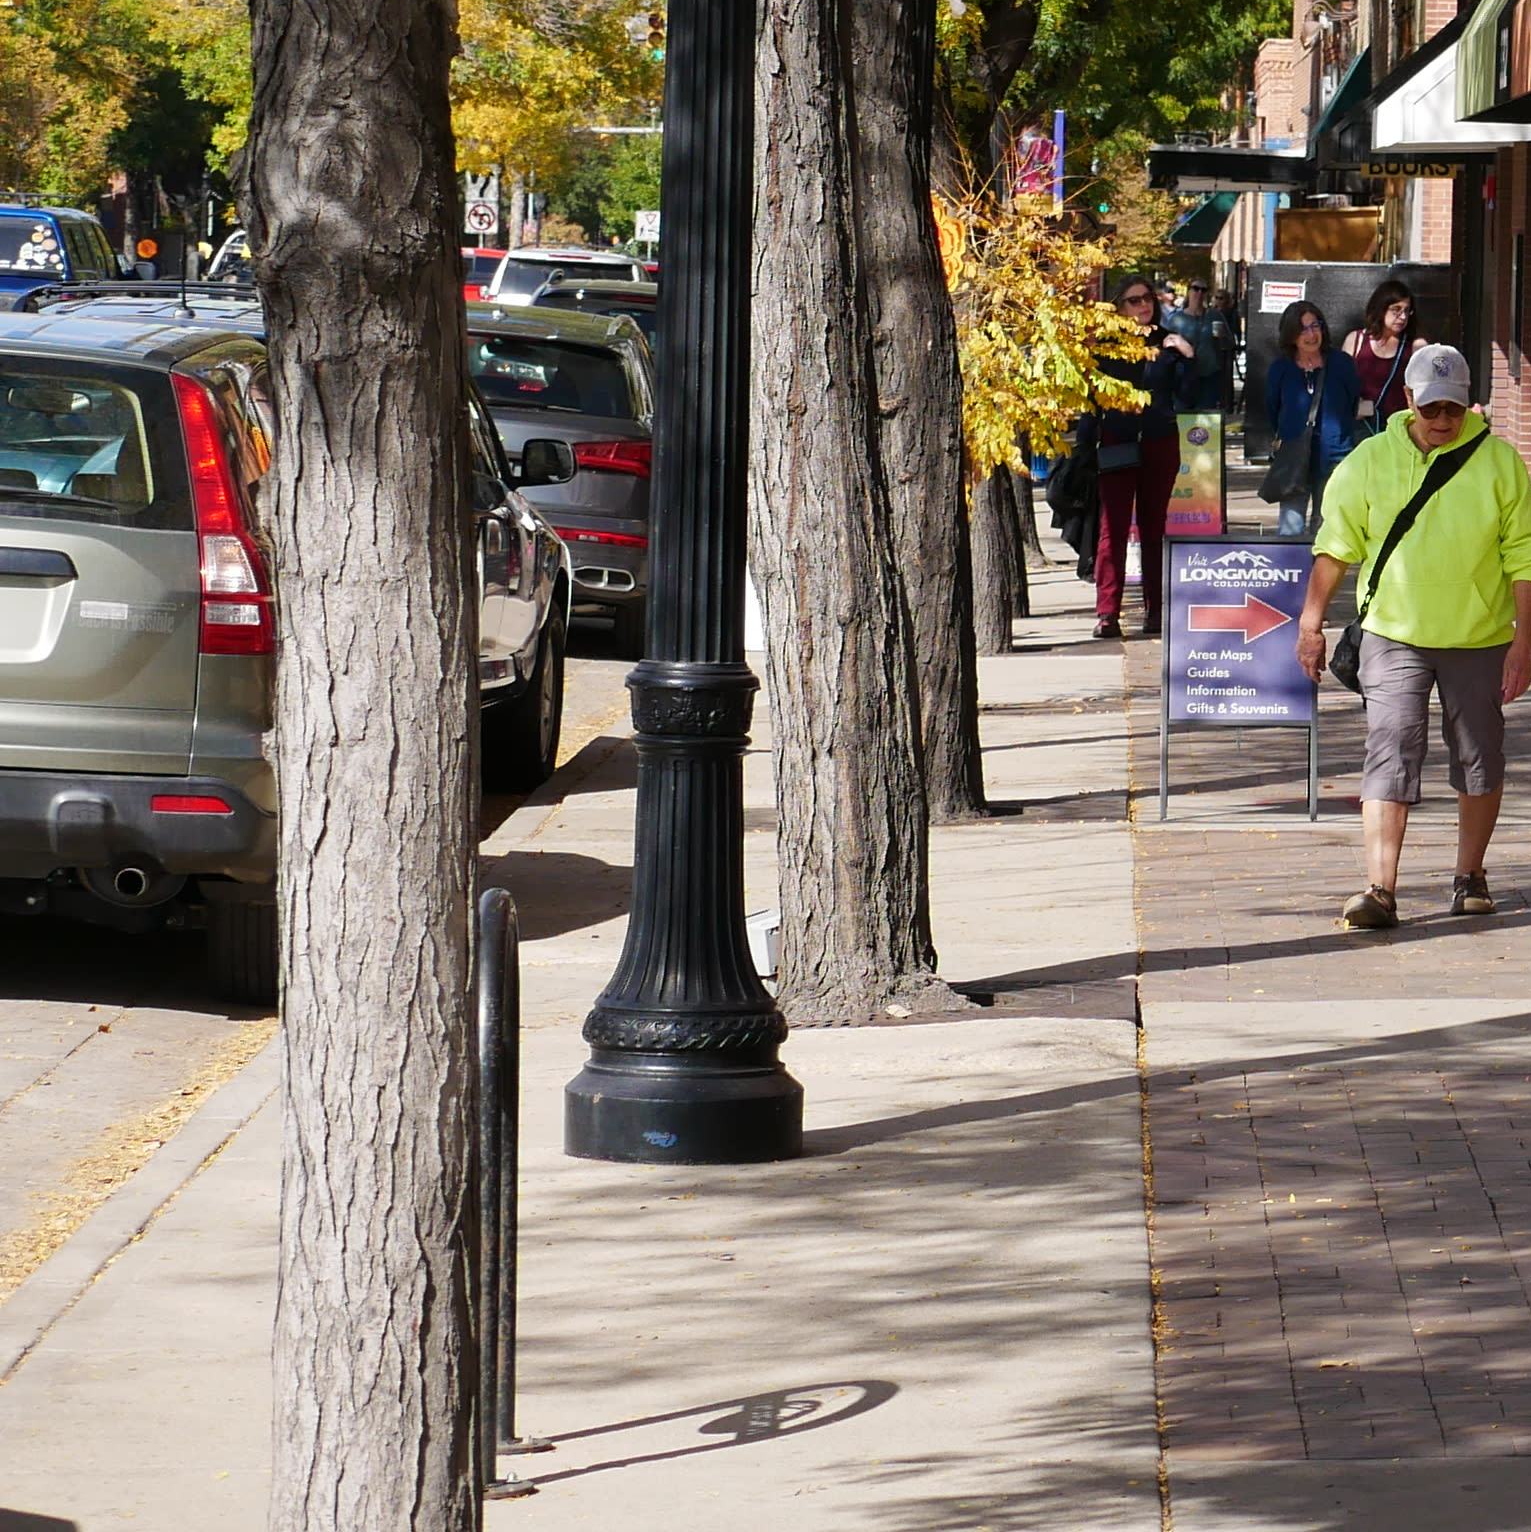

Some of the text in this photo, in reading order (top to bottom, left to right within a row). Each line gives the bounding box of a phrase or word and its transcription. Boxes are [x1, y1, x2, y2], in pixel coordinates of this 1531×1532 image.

[1179, 567, 1303, 583] LONGMONT
[1187, 649, 1253, 662] Area Maps
[1187, 666, 1230, 678] Guides
[1187, 684, 1257, 696] Information
[1187, 702, 1289, 715] Gifts & Souvenirs
